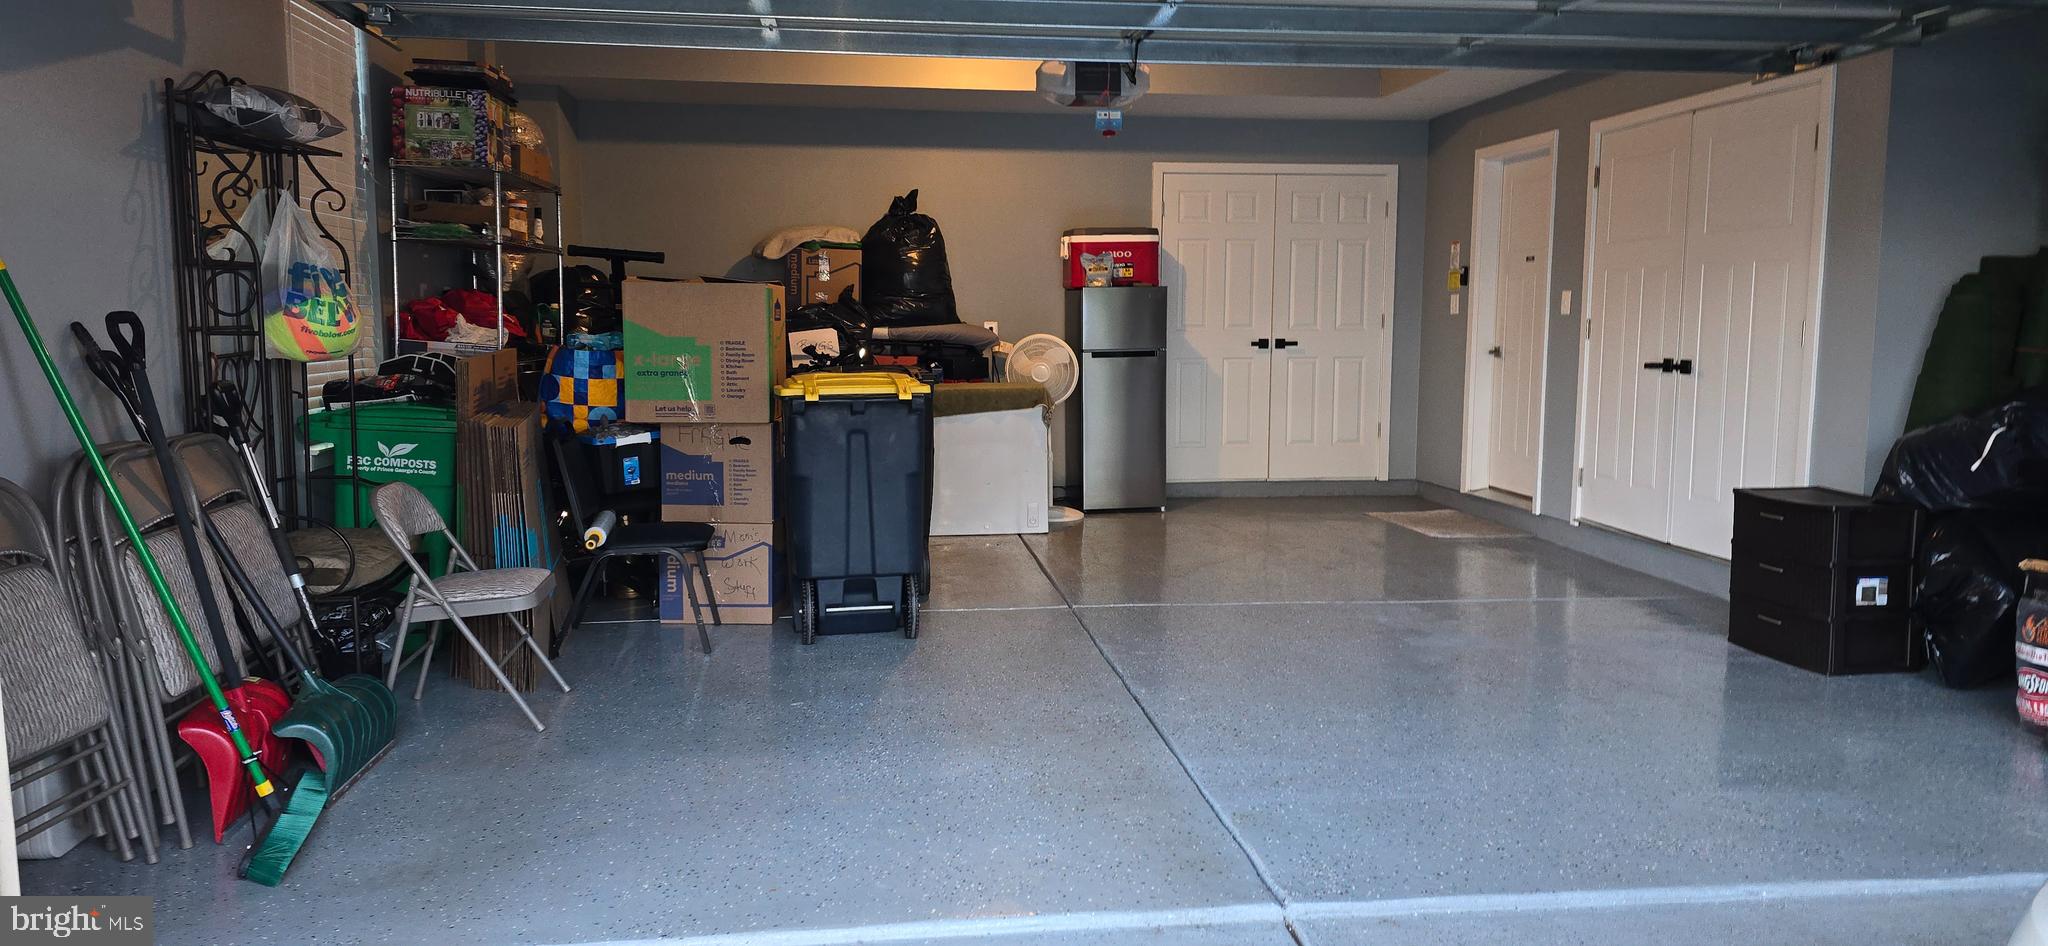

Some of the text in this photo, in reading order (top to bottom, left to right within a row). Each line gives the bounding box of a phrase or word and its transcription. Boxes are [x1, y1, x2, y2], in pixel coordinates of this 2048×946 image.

[1102, 250, 1132, 258] LOO
[790, 253, 800, 295] medium
[677, 405, 692, 413] help
[374, 457, 437, 470] COMPOSTS
[666, 469, 714, 481] medium
[666, 555, 681, 593] dium
